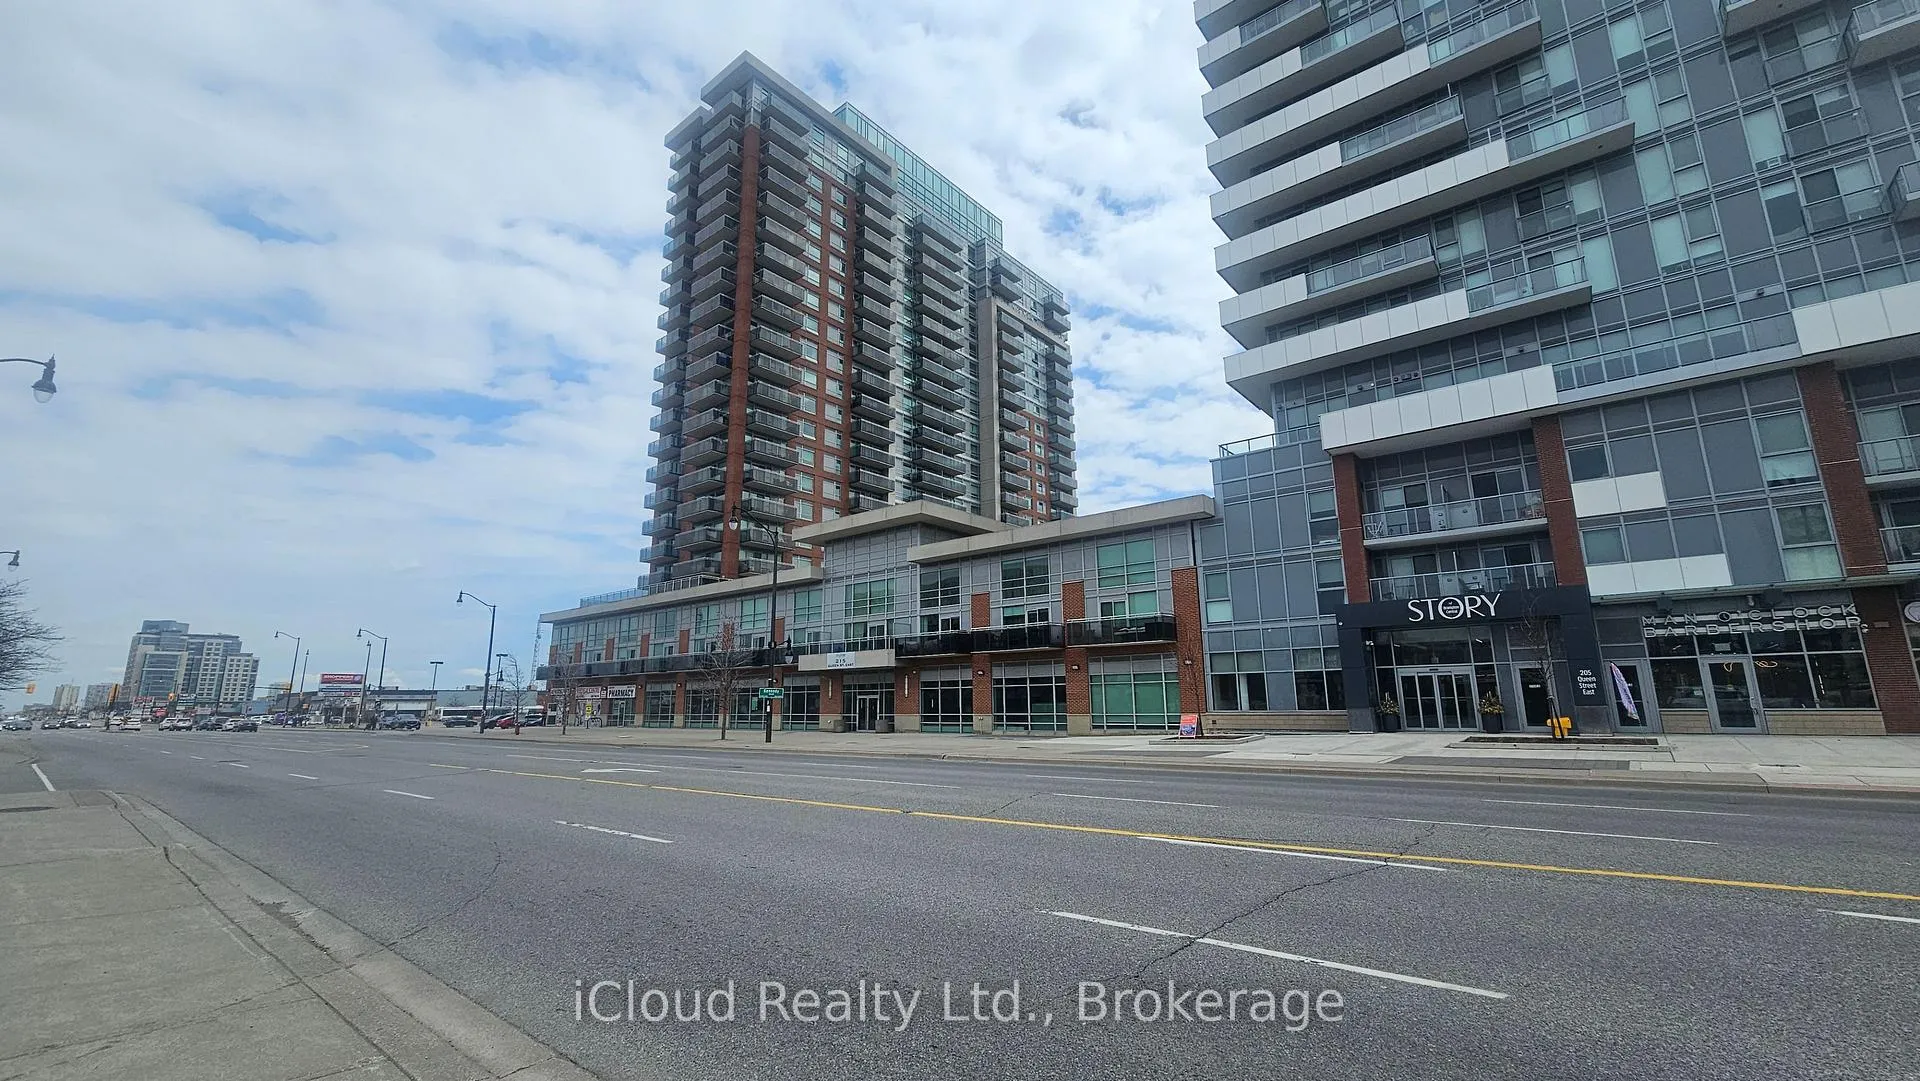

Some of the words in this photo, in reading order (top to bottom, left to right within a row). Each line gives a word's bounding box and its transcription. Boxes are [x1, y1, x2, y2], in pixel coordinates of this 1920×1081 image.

[1408, 593, 1500, 622] STORY
[1642, 613, 1698, 627] MAN
[1718, 603, 1859, 623] O'CLOCK
[1643, 616, 1862, 638] BARBERSHOP
[608, 688, 634, 698] PHARMACY
